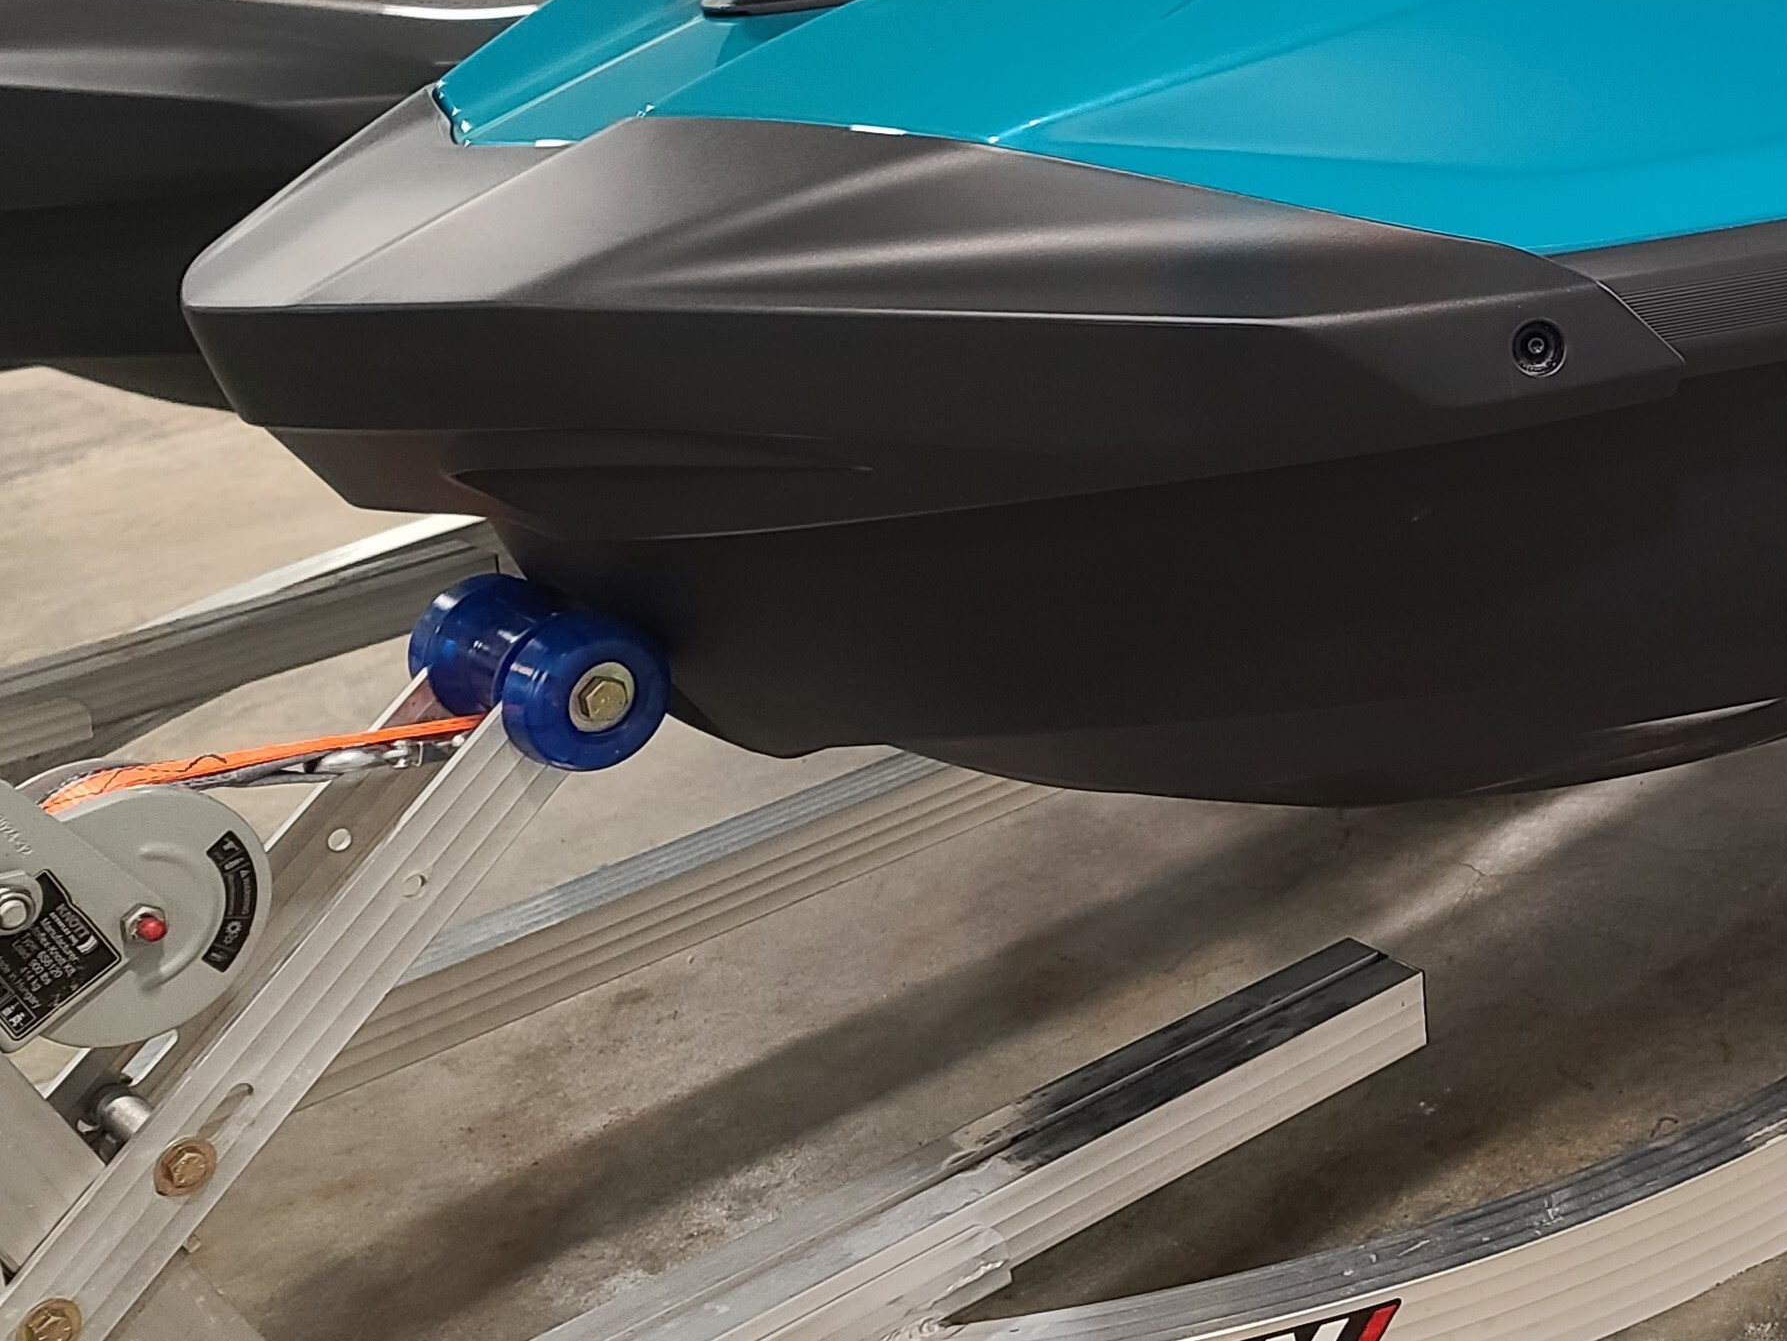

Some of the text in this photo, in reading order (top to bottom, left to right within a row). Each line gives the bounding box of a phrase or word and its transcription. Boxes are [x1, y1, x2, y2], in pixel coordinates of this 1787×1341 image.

[55, 902, 90, 939] KNOTT
[19, 967, 34, 981] 414
[14, 978, 41, 1008] Hungary
